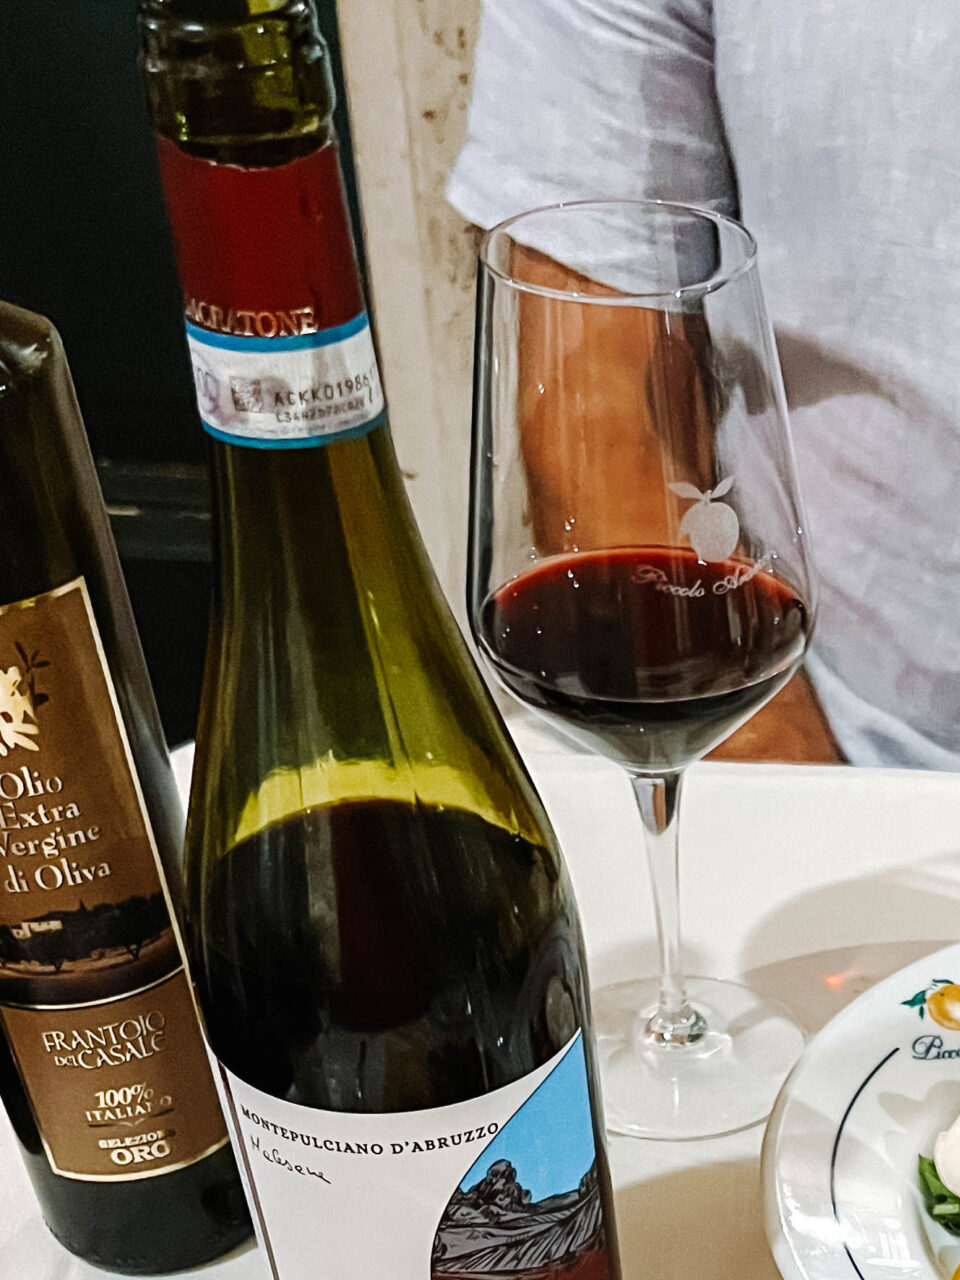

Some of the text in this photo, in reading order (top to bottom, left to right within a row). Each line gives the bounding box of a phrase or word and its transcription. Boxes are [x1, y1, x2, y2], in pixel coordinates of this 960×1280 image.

[185, 298, 318, 337] ACRATONE
[0, 766, 63, 800] Olio
[0, 802, 81, 830] Extra
[4, 857, 111, 893] di Oliva
[42, 1010, 165, 1052] FRANTOIO
[78, 1031, 164, 1070] CASALE
[94, 1082, 154, 1109] 100%
[98, 1129, 170, 1149] SELEZIO
[240, 1104, 500, 1155] MONTEPULCIANO D'ABRUZZO
[111, 1140, 171, 1165] ORO
